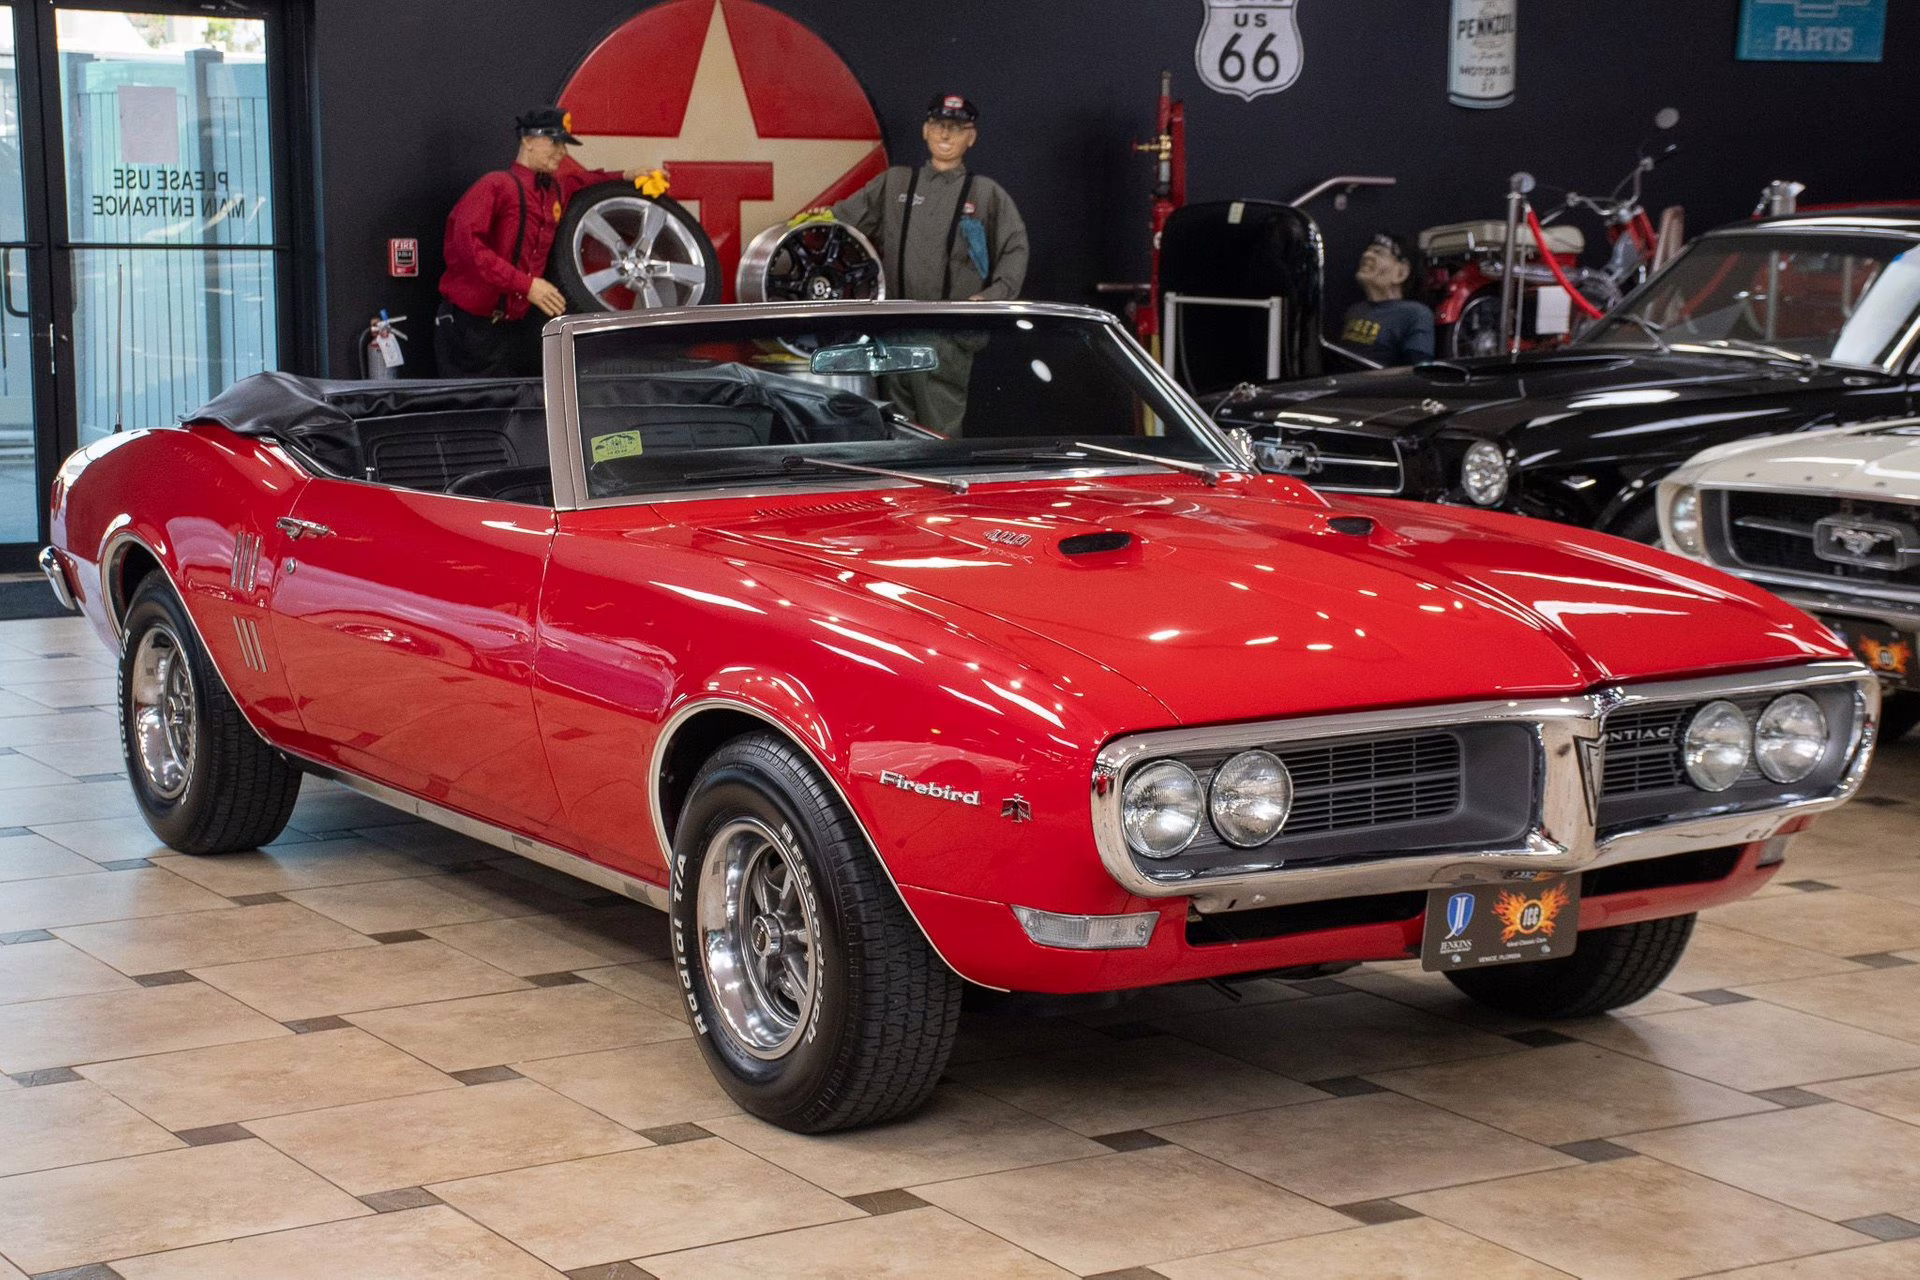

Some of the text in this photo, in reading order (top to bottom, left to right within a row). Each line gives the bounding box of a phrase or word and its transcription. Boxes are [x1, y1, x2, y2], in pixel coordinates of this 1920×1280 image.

[1234, 13, 1268, 27] US
[1774, 25, 1853, 52] PARTS
[1218, 32, 1279, 83] 66
[395, 240, 415, 250] FIRE
[1609, 726, 1672, 742] NTIAC
[880, 769, 982, 806] Firebird
[673, 854, 708, 1035] Radial T/A
